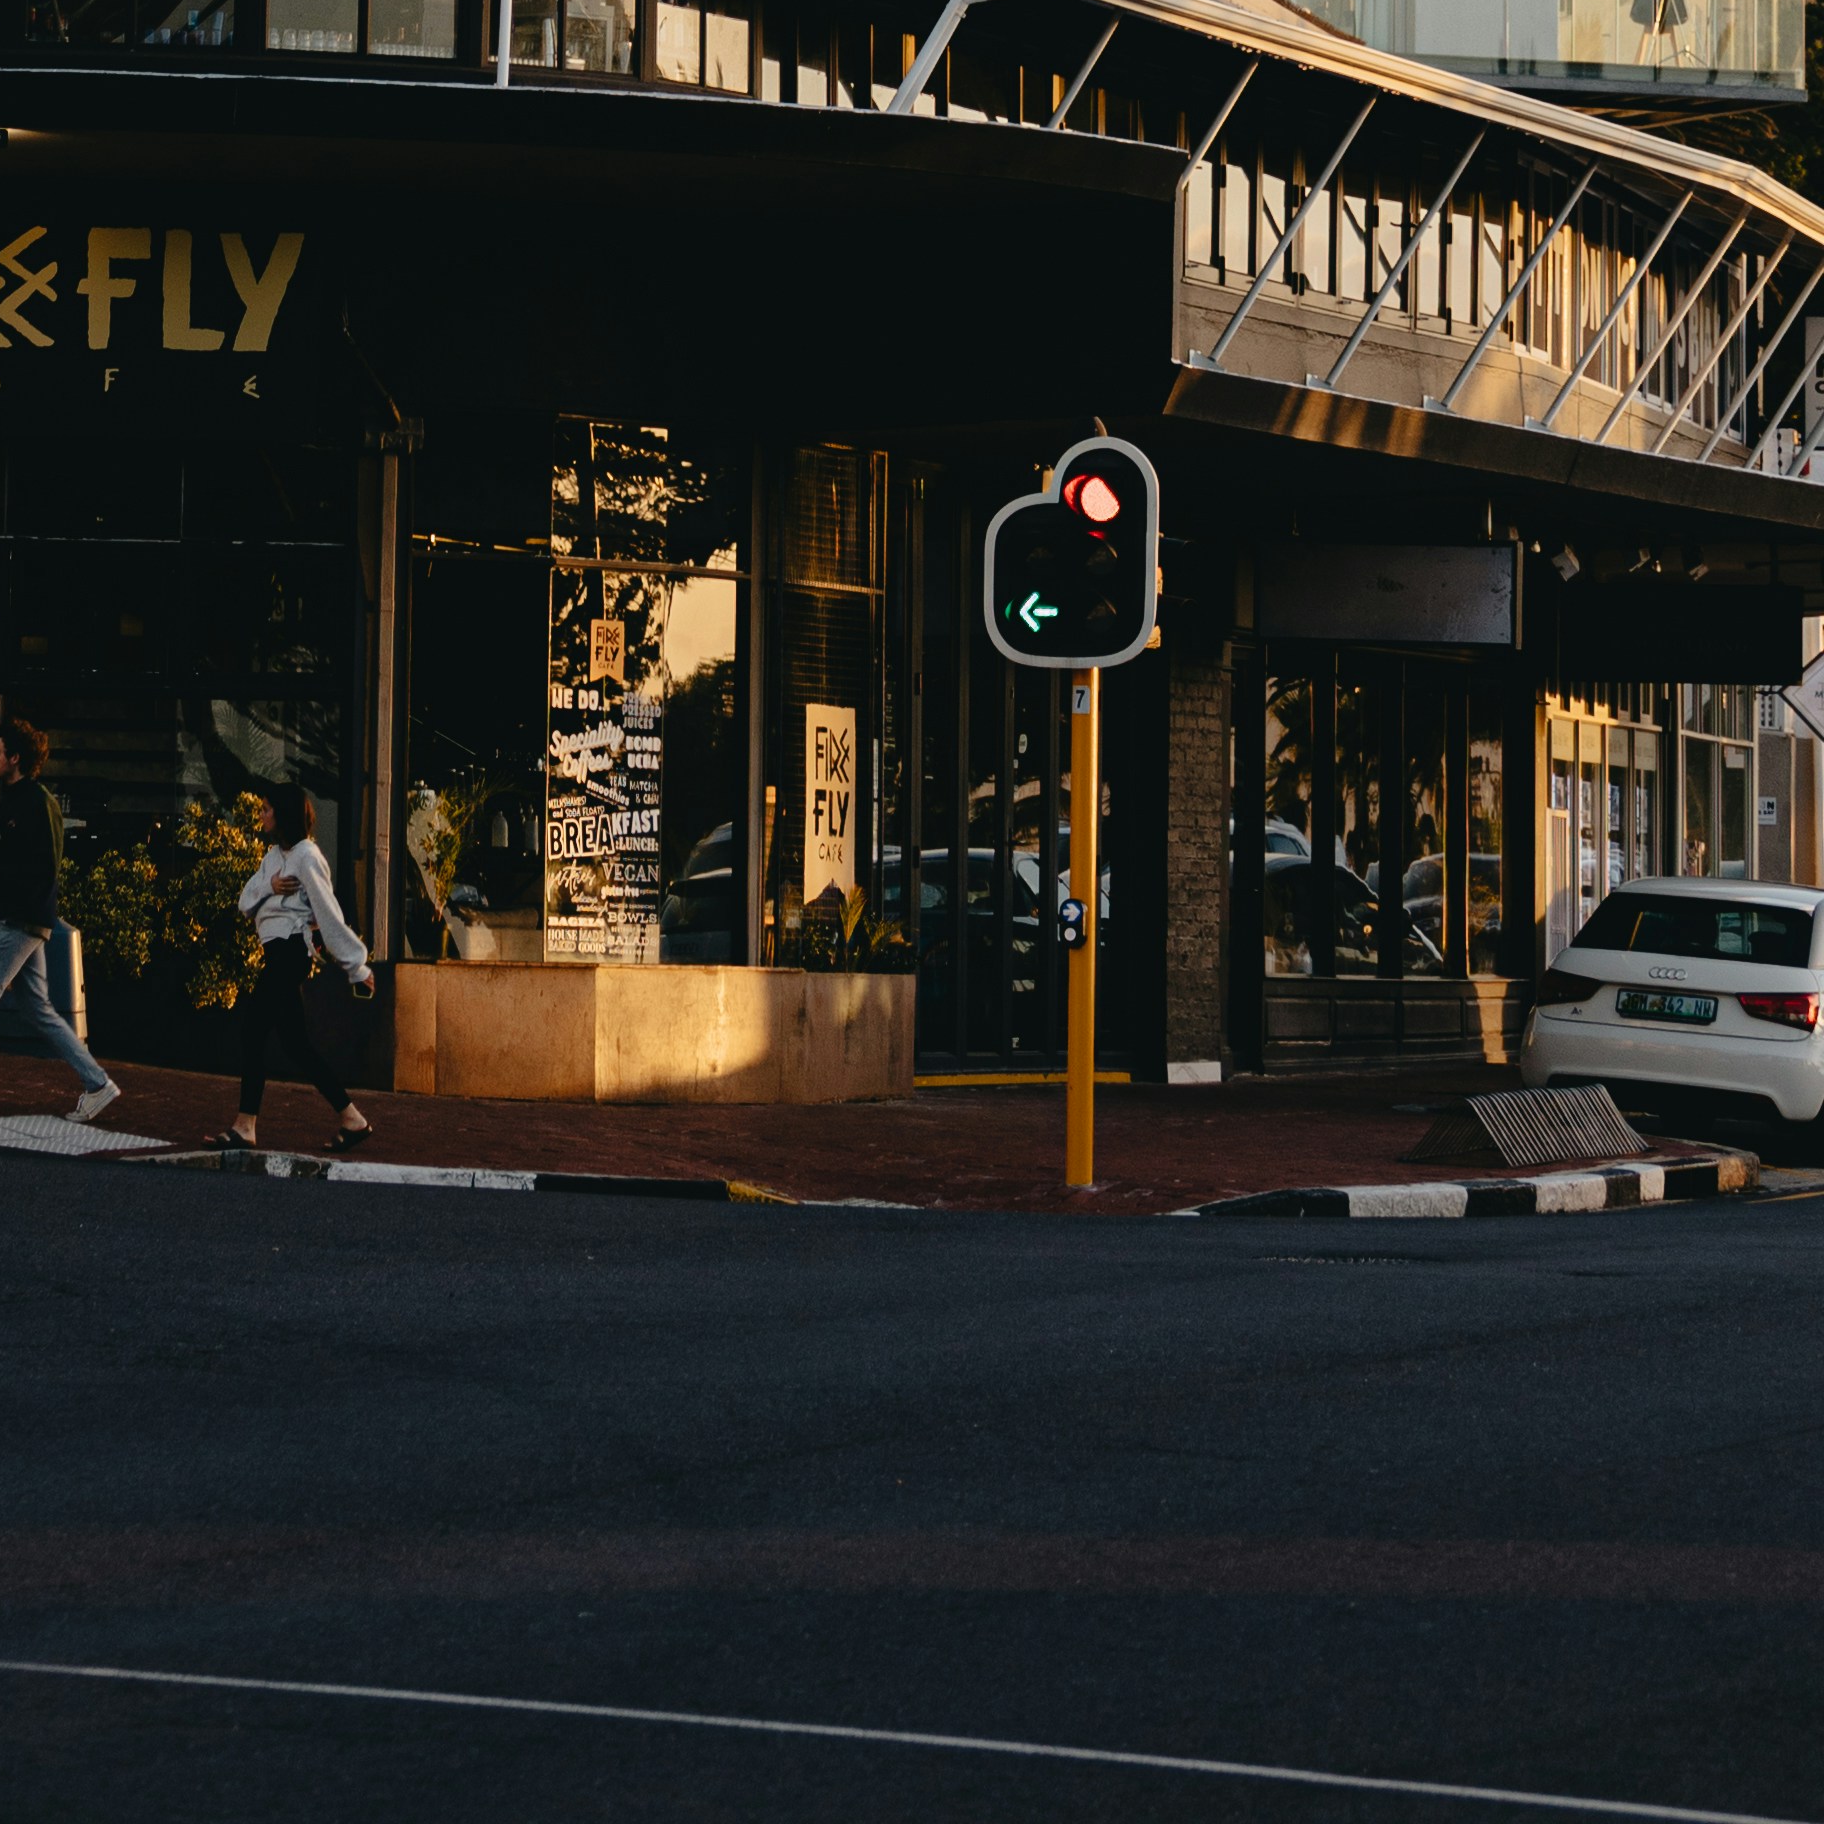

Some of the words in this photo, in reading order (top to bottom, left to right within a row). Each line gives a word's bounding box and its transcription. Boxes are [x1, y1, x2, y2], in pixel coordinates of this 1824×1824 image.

[76, 226, 305, 352] FLY
[595, 646, 620, 663] FLY
[551, 687, 574, 710] WE
[1075, 689, 1086, 709] 7
[622, 716, 655, 730] JUICES
[586, 779, 630, 807] smoothies
[629, 780, 659, 792] MATCHA
[813, 789, 850, 837] FLY
[602, 862, 660, 883] VEGAN
[607, 911, 658, 924] BOWLS
[547, 928, 578, 941] HOUSE
[578, 942, 607, 954] GOODS
